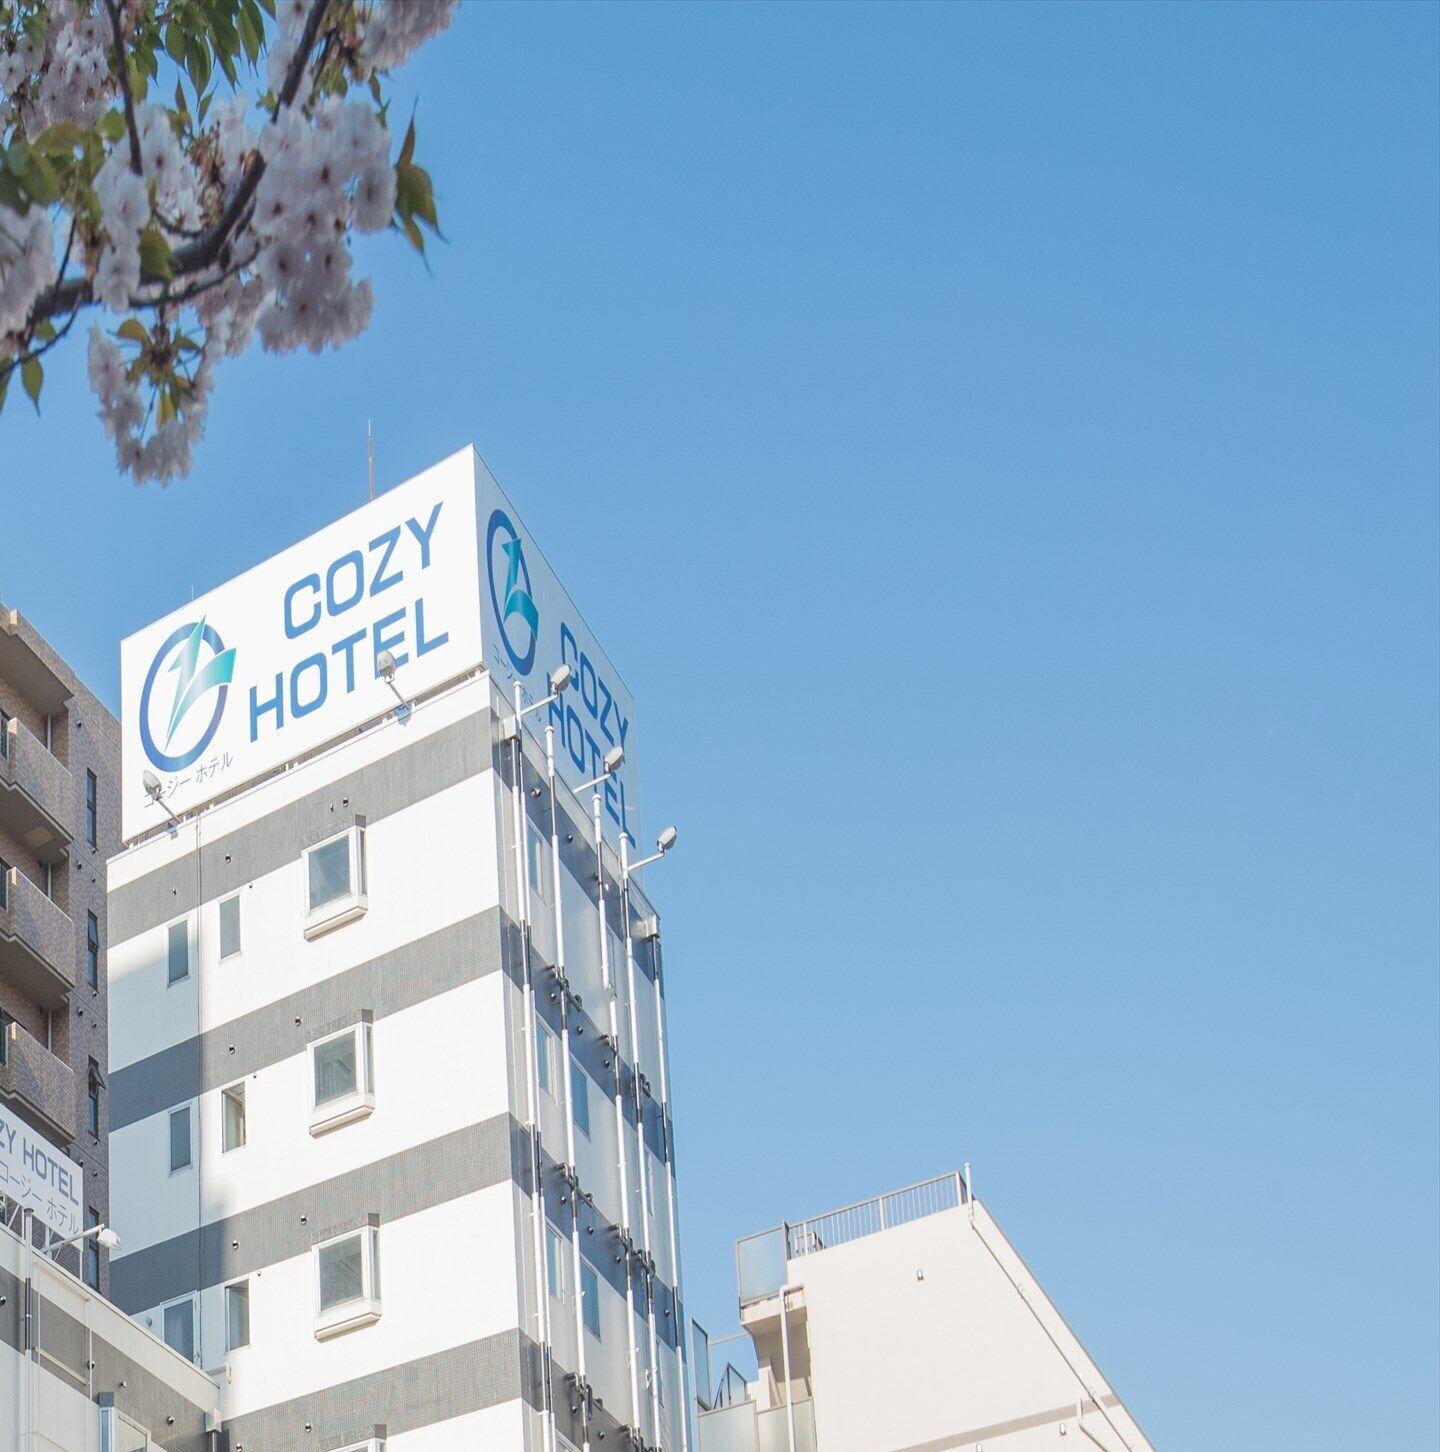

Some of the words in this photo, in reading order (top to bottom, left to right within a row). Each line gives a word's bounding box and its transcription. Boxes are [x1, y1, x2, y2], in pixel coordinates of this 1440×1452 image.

[283, 501, 444, 640] COZY
[248, 597, 450, 743] HOTEL
[560, 621, 629, 764] COZY
[195, 751, 234, 784] ホテル
[546, 670, 636, 850] HOTEL
[0, 1160, 43, 1202] コージー
[46, 1199, 79, 1235] ホテル
[22, 1137, 80, 1207] HOTEL
